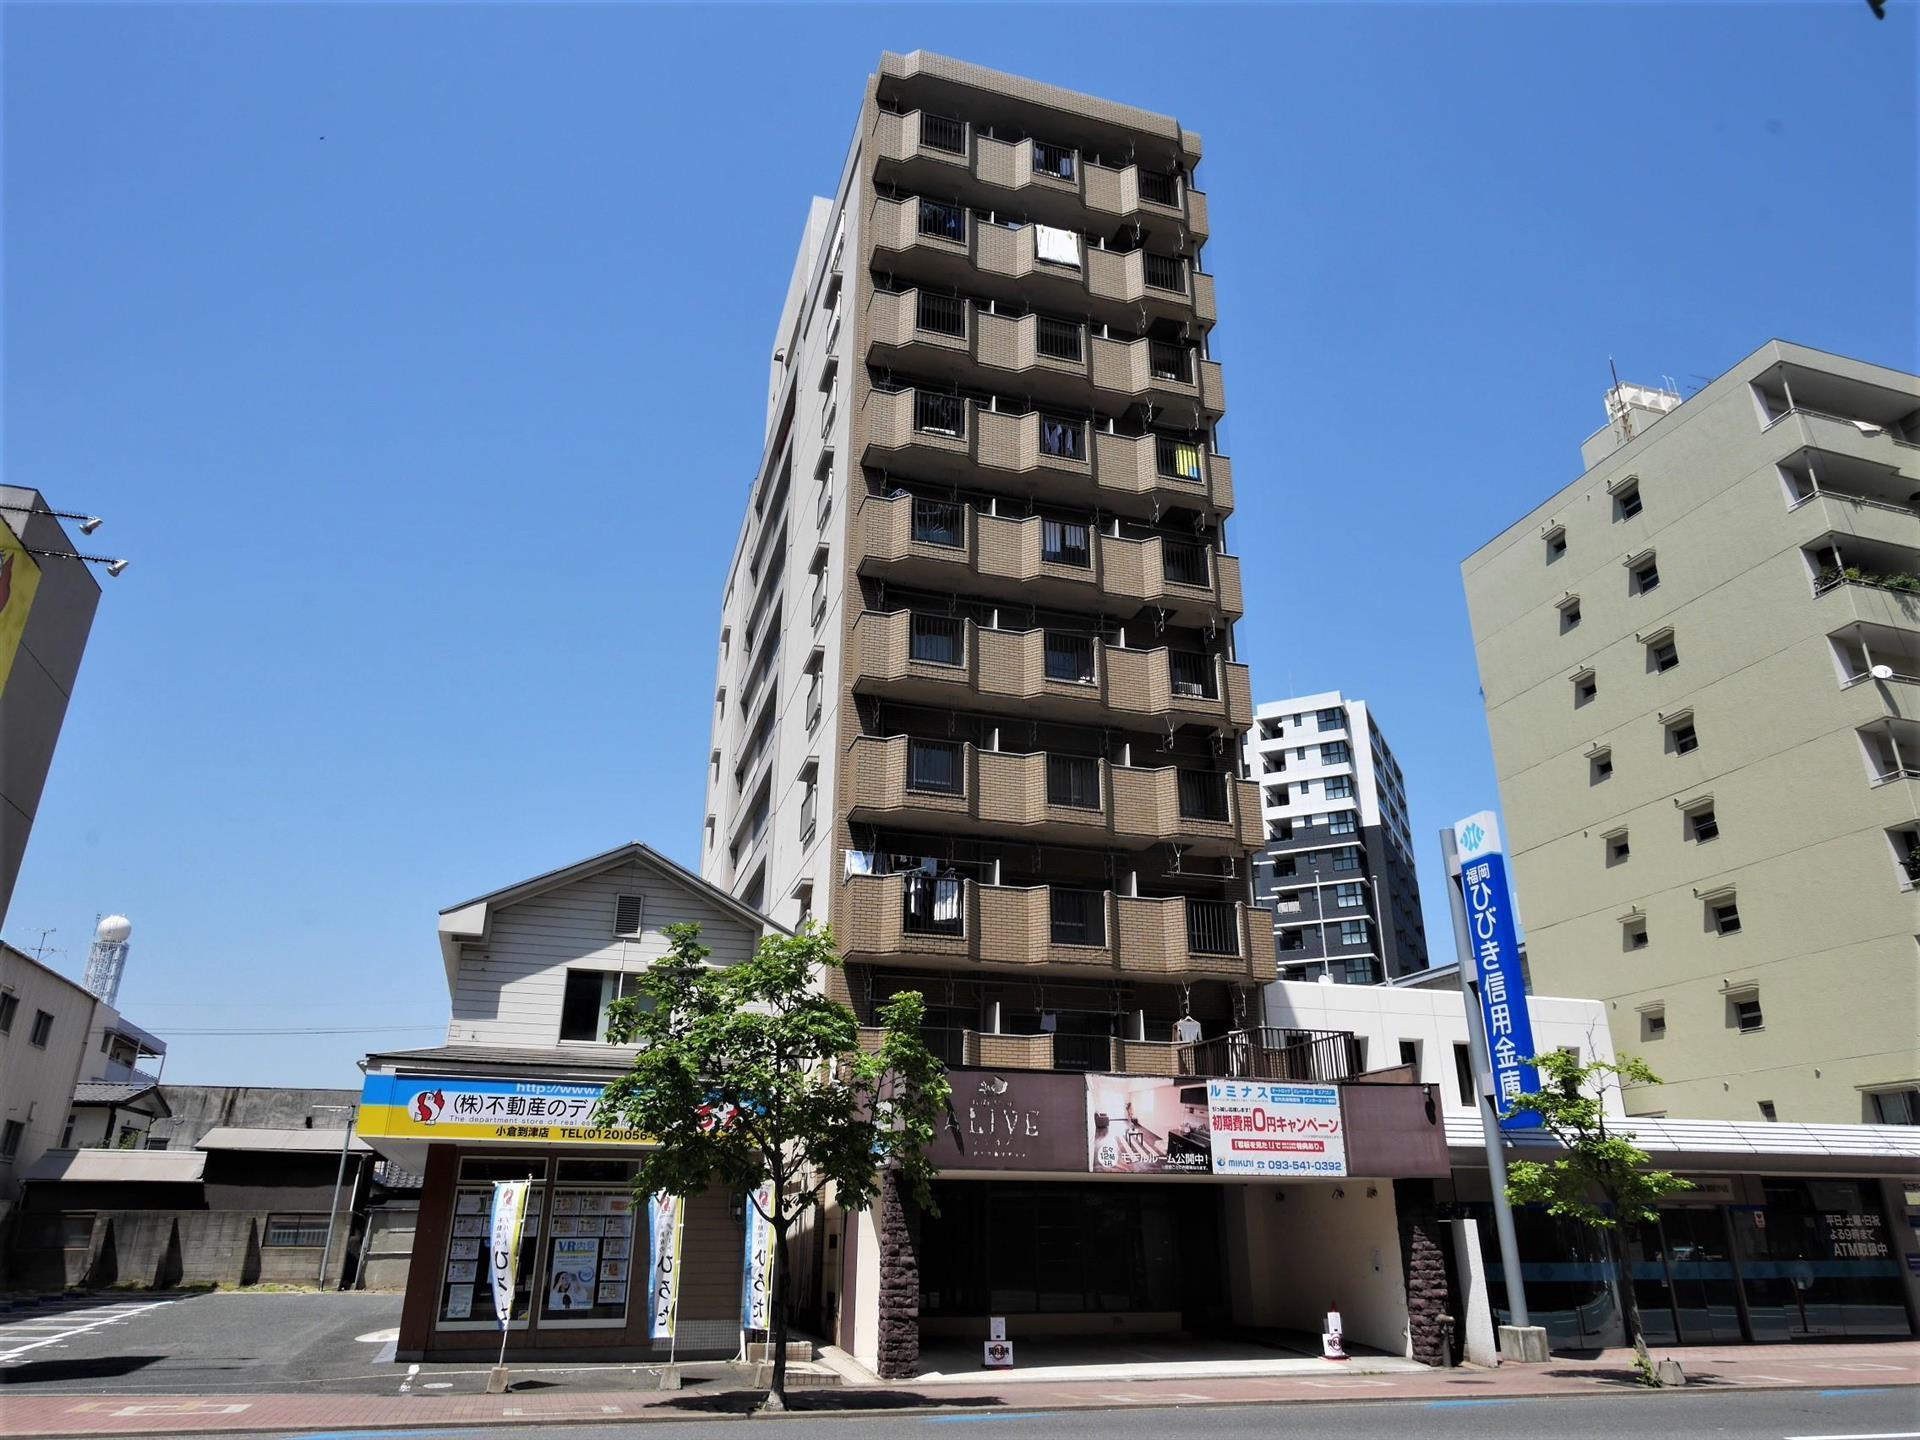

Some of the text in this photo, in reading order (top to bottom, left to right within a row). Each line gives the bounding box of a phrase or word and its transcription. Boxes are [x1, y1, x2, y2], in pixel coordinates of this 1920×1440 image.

[1466, 862, 1490, 885] 福岡
[1470, 884, 1522, 1105] ひびき信用金庫
[1210, 1085, 1268, 1098] ルミナス
[469, 1116, 518, 1124] department
[1212, 1108, 1339, 1133] 初期費用0円キャンペーン
[496, 1127, 550, 1138] 小倉到津店
[1121, 1152, 1208, 1165] モデルルーム公開中!
[1268, 1160, 1342, 1171] 093-541-0392
[1830, 1228, 1876, 1240] よる9時まで
[1834, 1242, 1888, 1257] ATM取扱中
